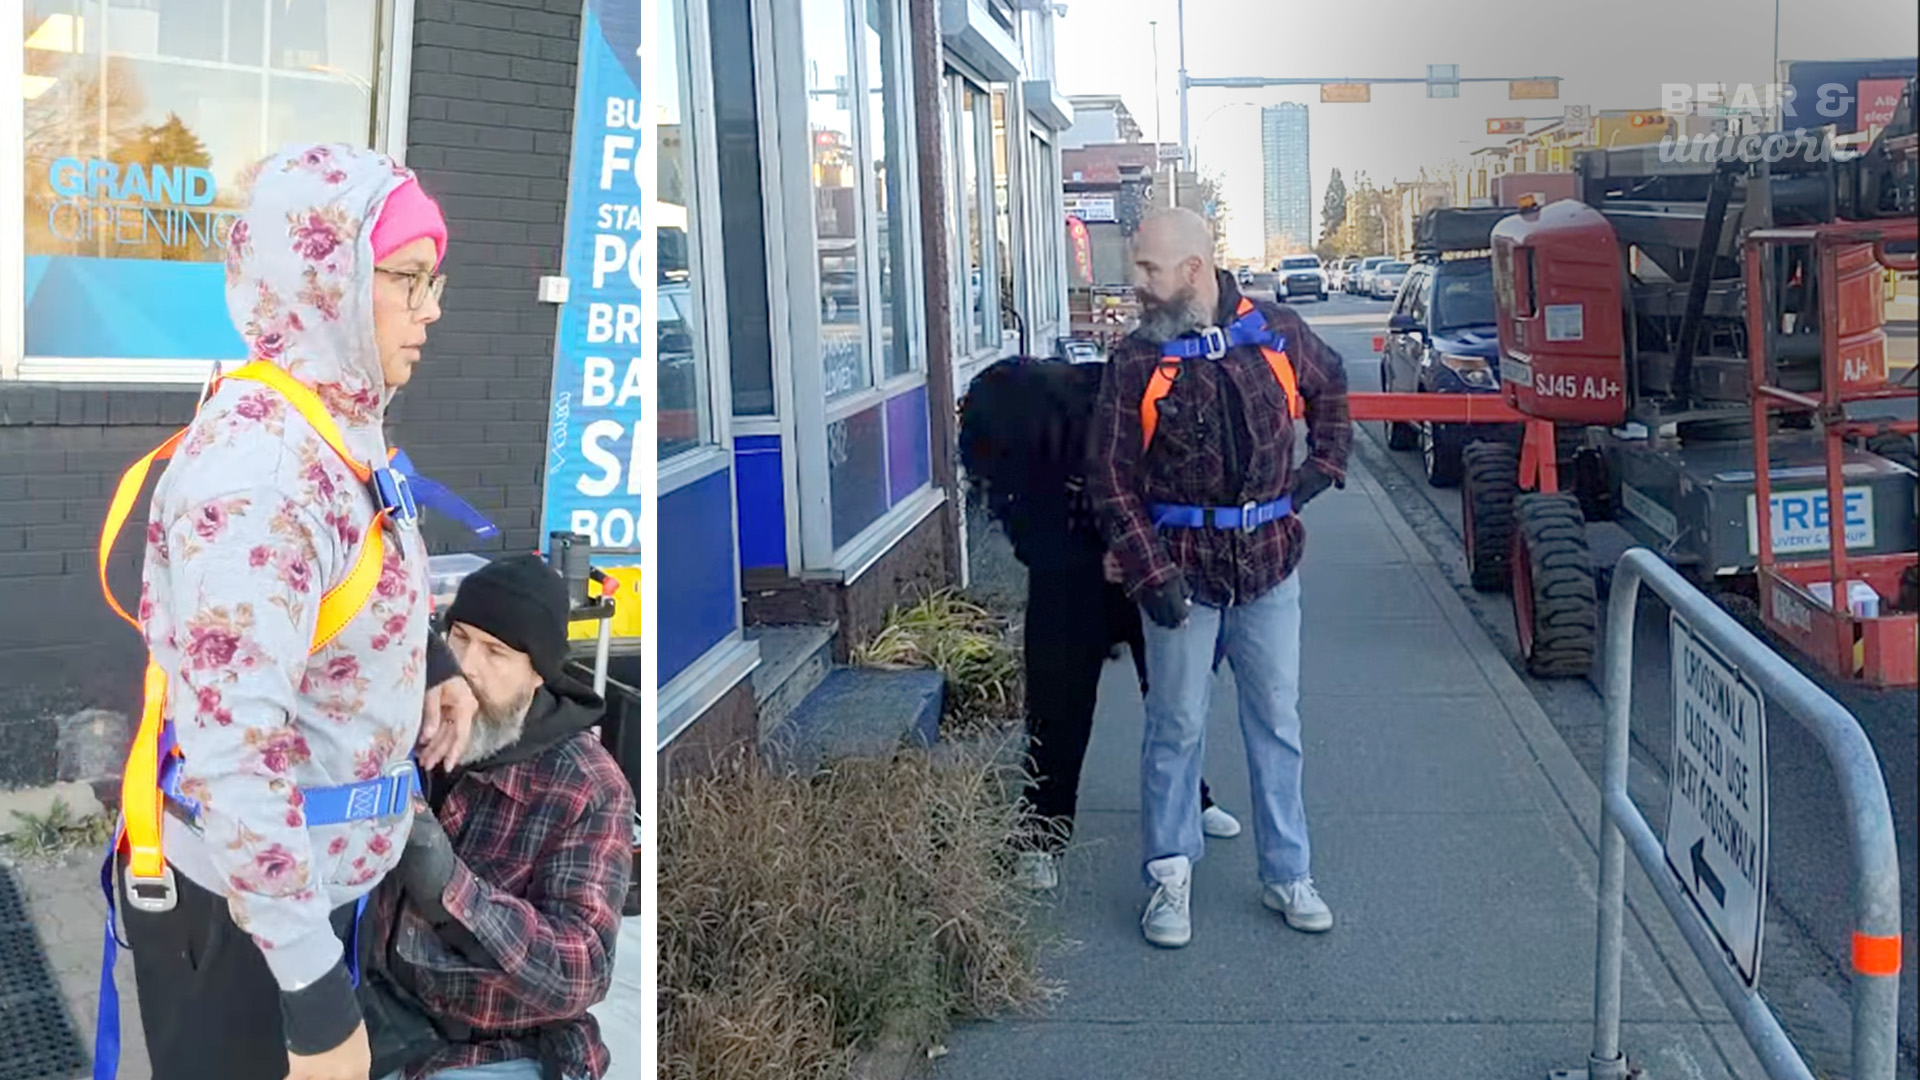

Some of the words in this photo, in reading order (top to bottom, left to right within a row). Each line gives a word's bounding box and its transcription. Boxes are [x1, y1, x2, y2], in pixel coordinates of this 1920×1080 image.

[50, 156, 217, 206] GRAND
[1535, 372, 1578, 398] SJ45
[1581, 375, 1621, 400] AJ+
[571, 507, 641, 549] BO
[1683, 645, 1747, 744] CROSSWALK
[1684, 700, 1722, 778] CLOSED
[1726, 744, 1750, 813] USE
[1699, 775, 1757, 890] CROSSWALK
